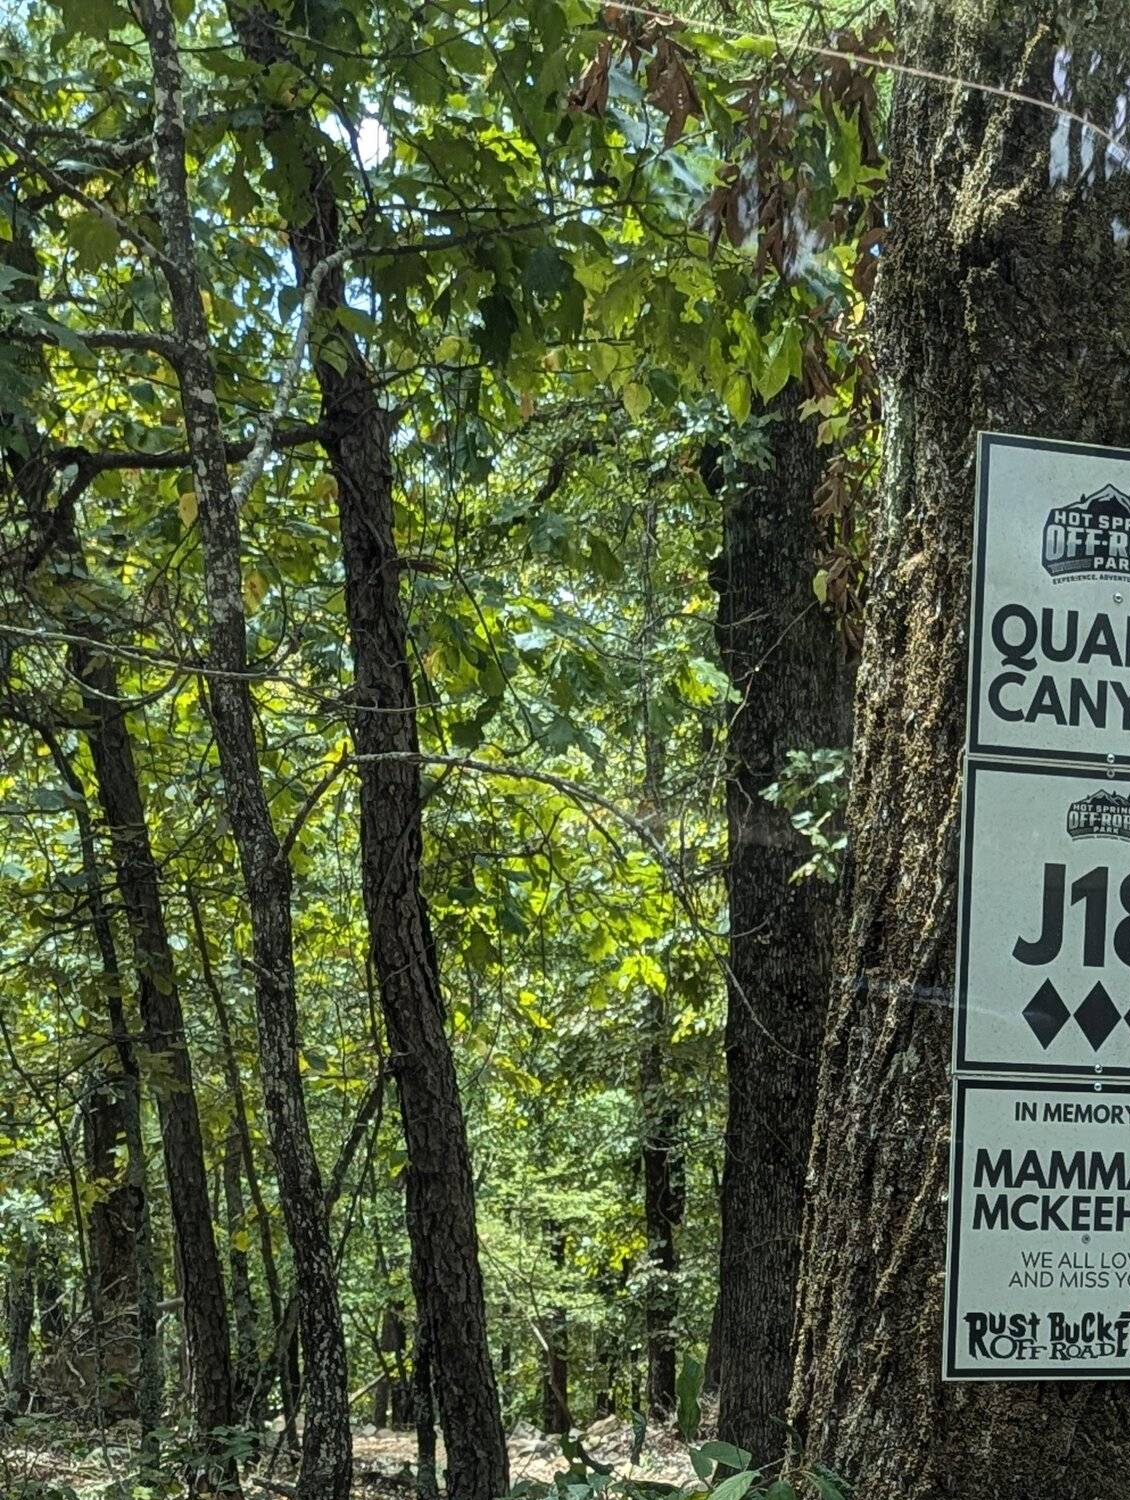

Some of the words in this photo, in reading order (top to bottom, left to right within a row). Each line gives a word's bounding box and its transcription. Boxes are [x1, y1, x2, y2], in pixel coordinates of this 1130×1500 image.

[1055, 511, 1093, 526] HOT
[1015, 1102, 1036, 1121] IN
[1021, 1251, 1053, 1269] WE
[1058, 1252, 1094, 1269] ALL
[1008, 1271, 1054, 1288] AND
[1060, 1272, 1110, 1288] MISS
